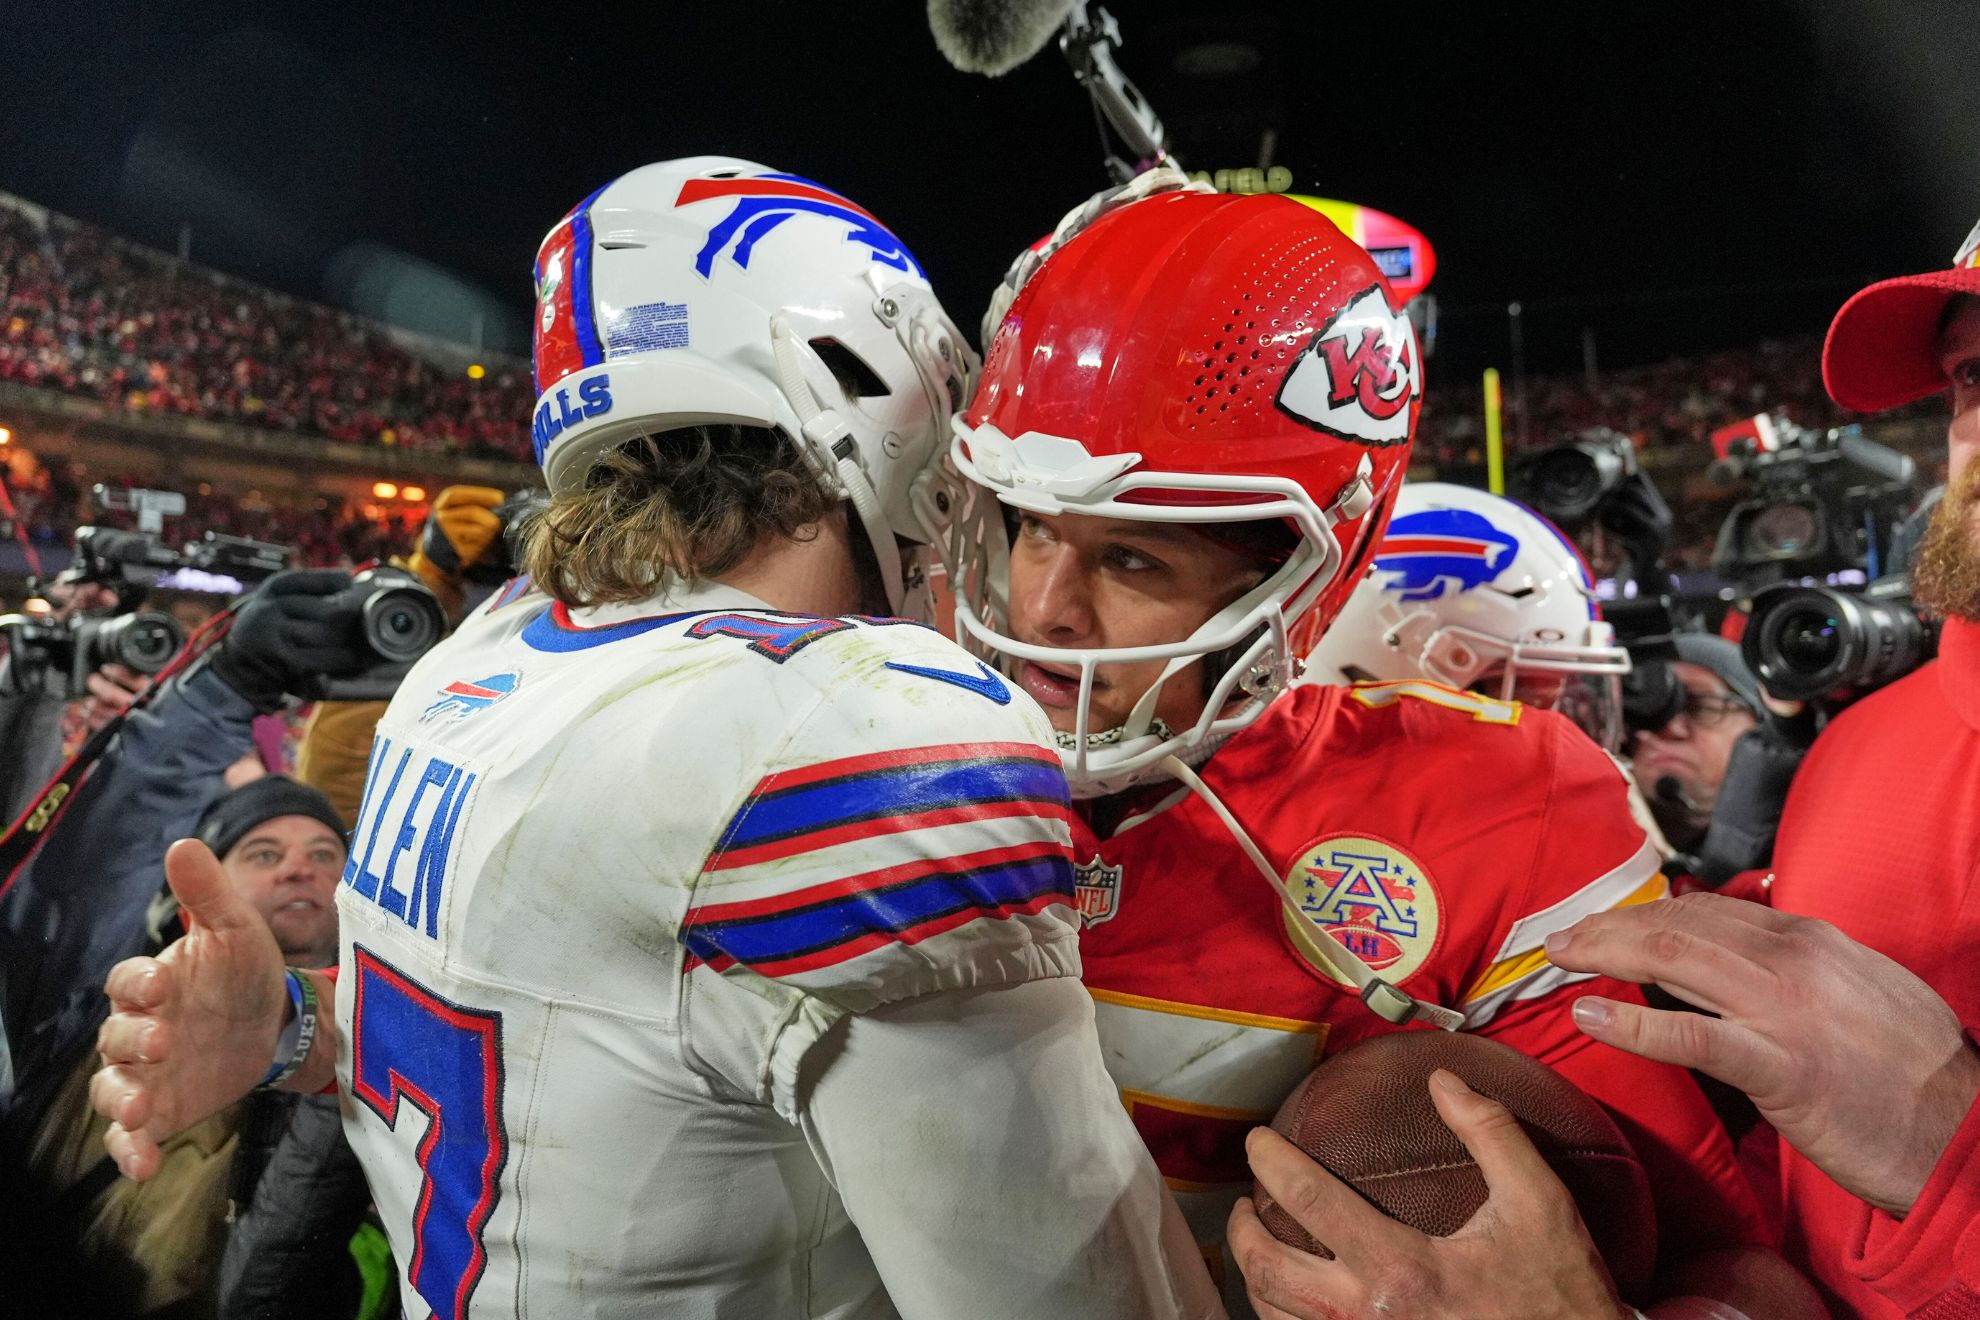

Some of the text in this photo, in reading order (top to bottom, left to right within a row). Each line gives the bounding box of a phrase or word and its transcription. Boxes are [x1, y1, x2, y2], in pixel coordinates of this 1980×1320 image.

[1317, 327, 1411, 421] KC
[343, 734, 477, 940] LLEN
[1075, 886, 1109, 915] NFL
[1344, 933, 1379, 957] LH
[292, 1013, 316, 1063] LUK3
